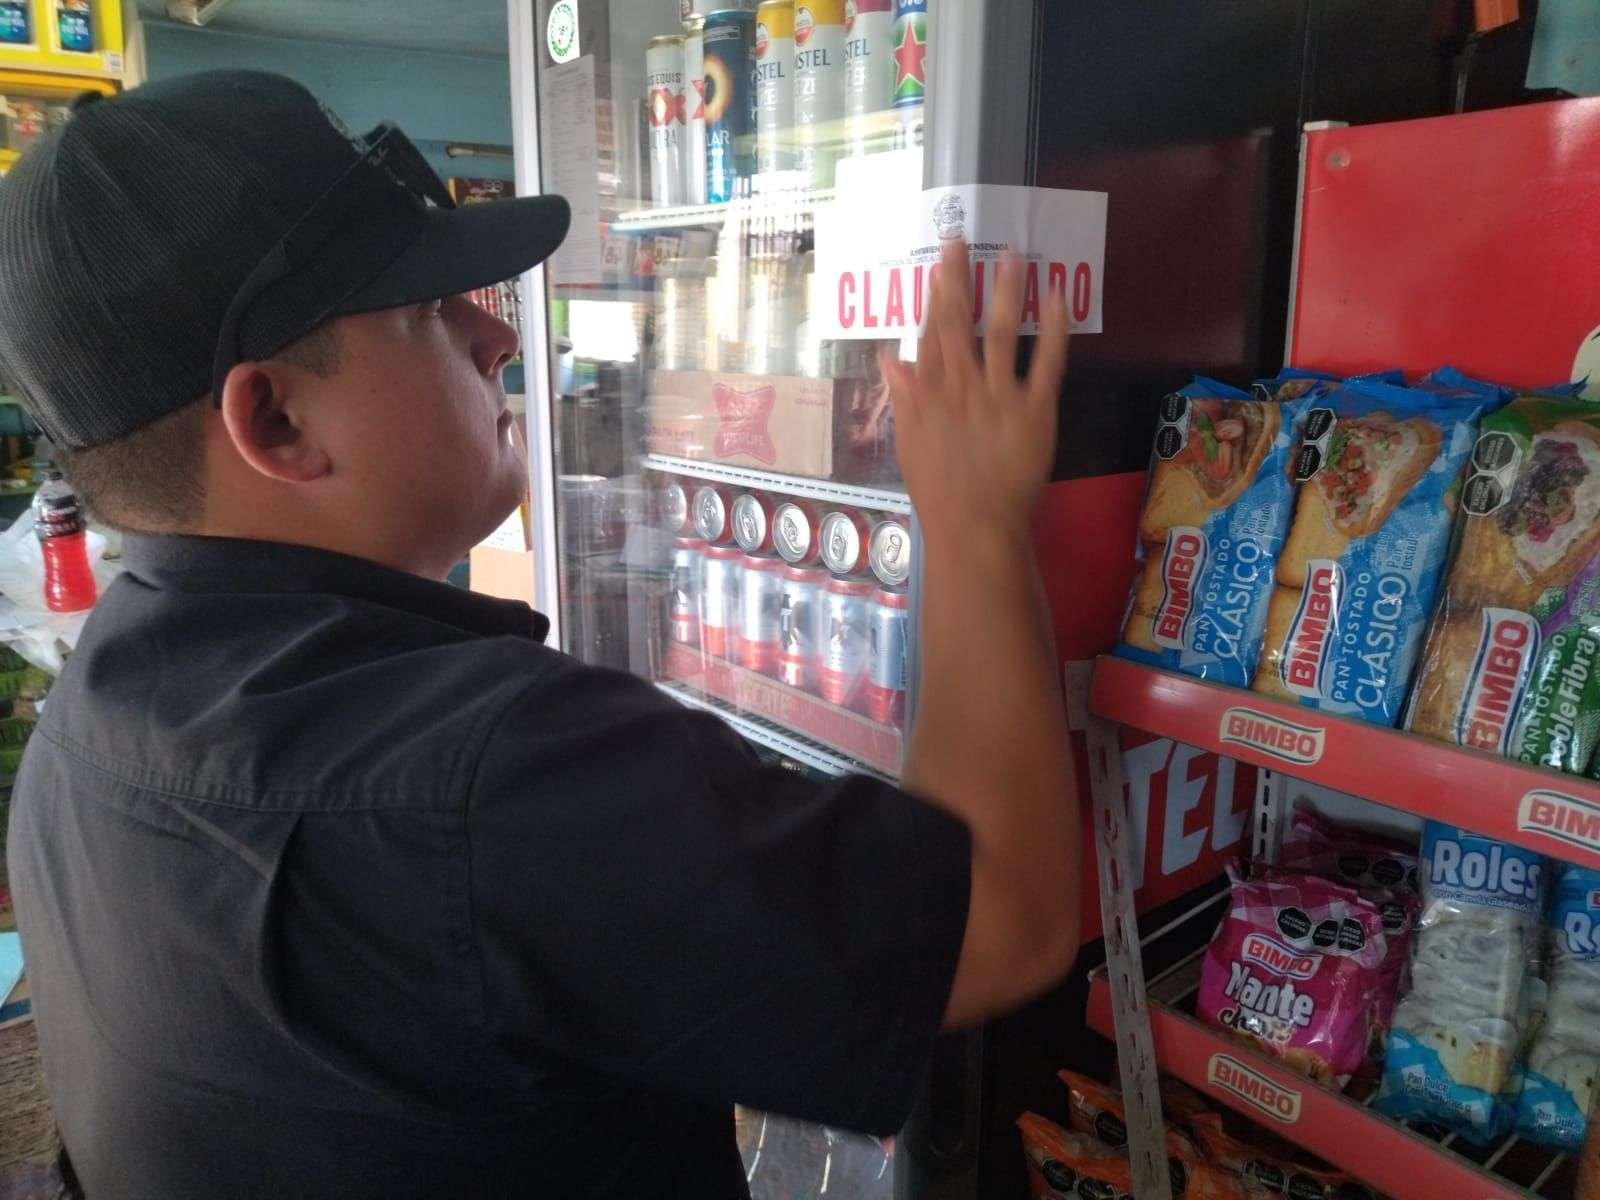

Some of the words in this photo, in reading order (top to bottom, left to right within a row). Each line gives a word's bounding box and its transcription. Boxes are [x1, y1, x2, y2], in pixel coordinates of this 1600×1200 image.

[838, 261, 1092, 329] CLAUUADO
[1157, 534, 1201, 640] BIMBO
[1194, 619, 1211, 651] PAN
[1203, 539, 1231, 611] TOSTADO
[1214, 540, 1261, 659] CLÁSICO
[1288, 568, 1335, 689] BIMBO
[1334, 666, 1352, 701] PAN
[1343, 572, 1372, 654] TOSTADO
[1355, 576, 1407, 708] CLÁSICO
[1466, 620, 1529, 750] BIMBO
[1558, 637, 1596, 702] Fibra
[1226, 714, 1317, 757] BIMBO
[1520, 725, 1538, 763] PAN
[1534, 634, 1567, 722] TOSTADO
[1431, 839, 1541, 899] Roles
[1528, 797, 1600, 841] BIM
[1248, 939, 1314, 974] BIMBO
[1215, 1060, 1294, 1116] BIMBO
